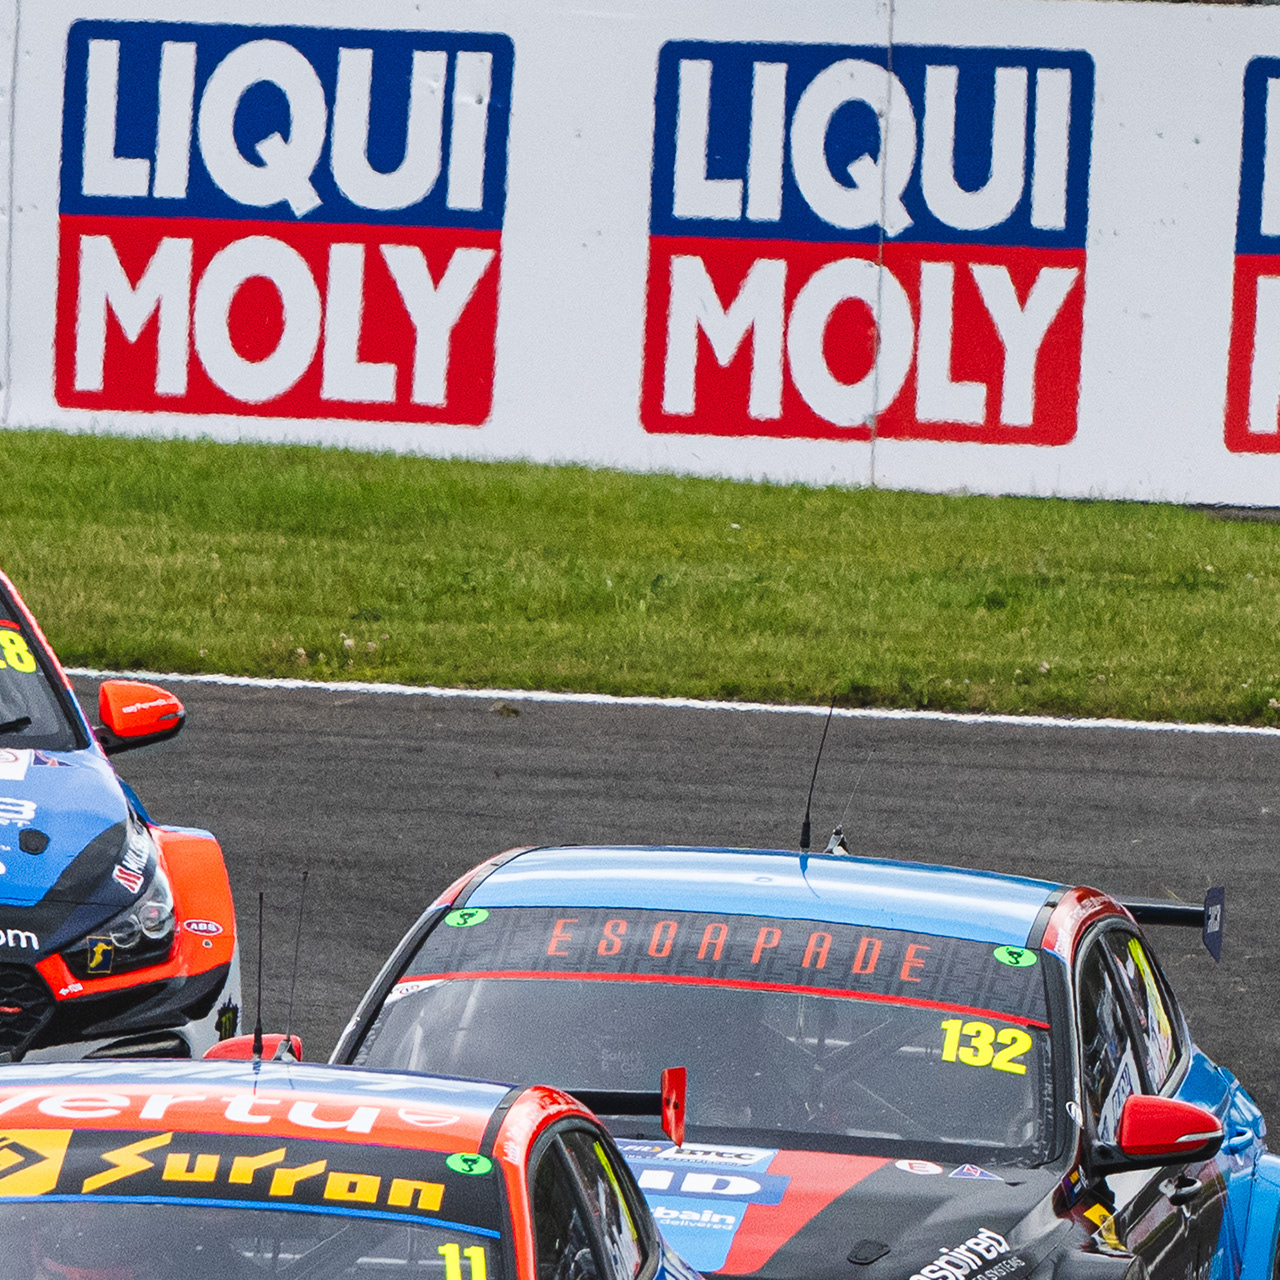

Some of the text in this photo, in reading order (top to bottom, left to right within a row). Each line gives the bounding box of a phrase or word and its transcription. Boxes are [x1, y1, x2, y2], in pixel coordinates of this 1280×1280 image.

[81, 38, 493, 218] LIQUI
[672, 58, 1071, 237] LIQUI
[74, 234, 496, 408] MOLY
[660, 254, 1080, 428] MOLY
[191, 921, 216, 934] ABS
[546, 917, 931, 984] ESCAPADE
[940, 1019, 1032, 1075] 132
[82, 1131, 445, 1211] Surron
[659, 1217, 734, 1231] delivered
